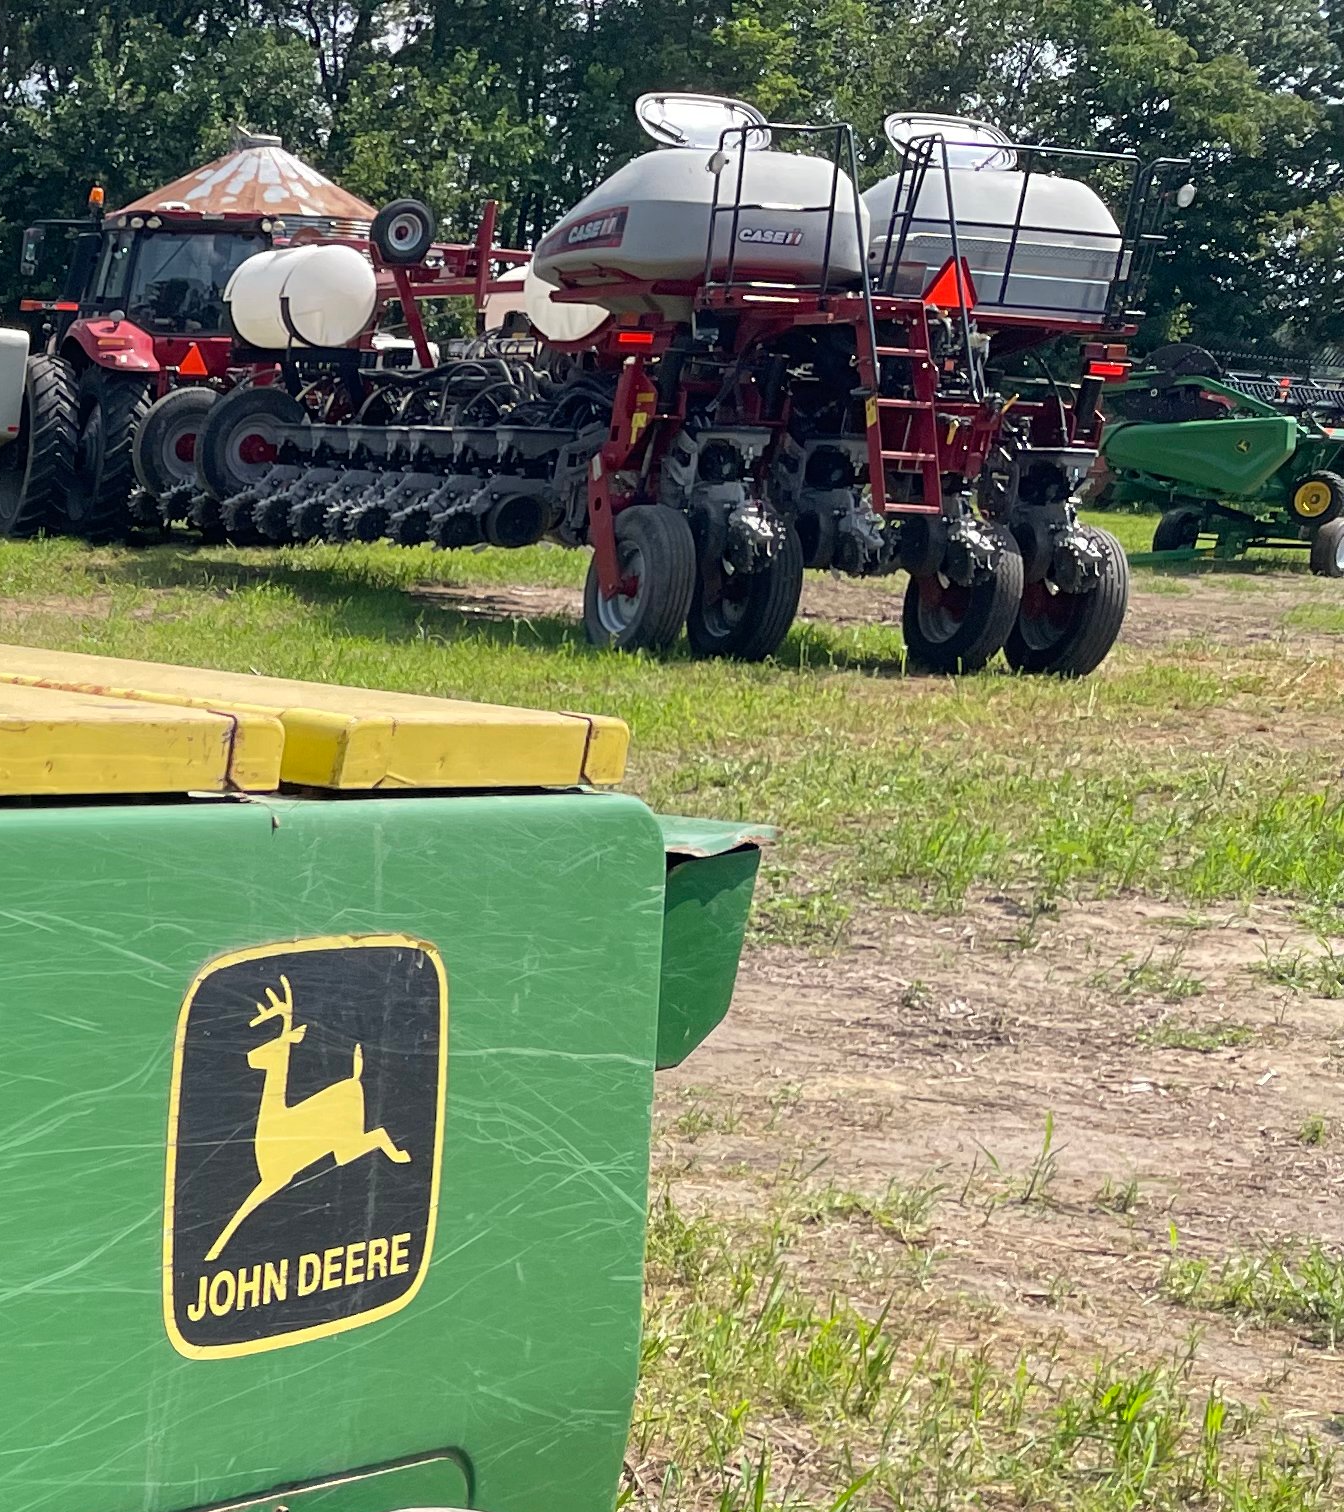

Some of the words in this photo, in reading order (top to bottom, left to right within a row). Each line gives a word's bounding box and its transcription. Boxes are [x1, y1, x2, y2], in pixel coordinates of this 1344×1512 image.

[738, 227, 787, 245] CASE
[186, 1257, 290, 1323] JOHN
[296, 1231, 411, 1298] DEERE
